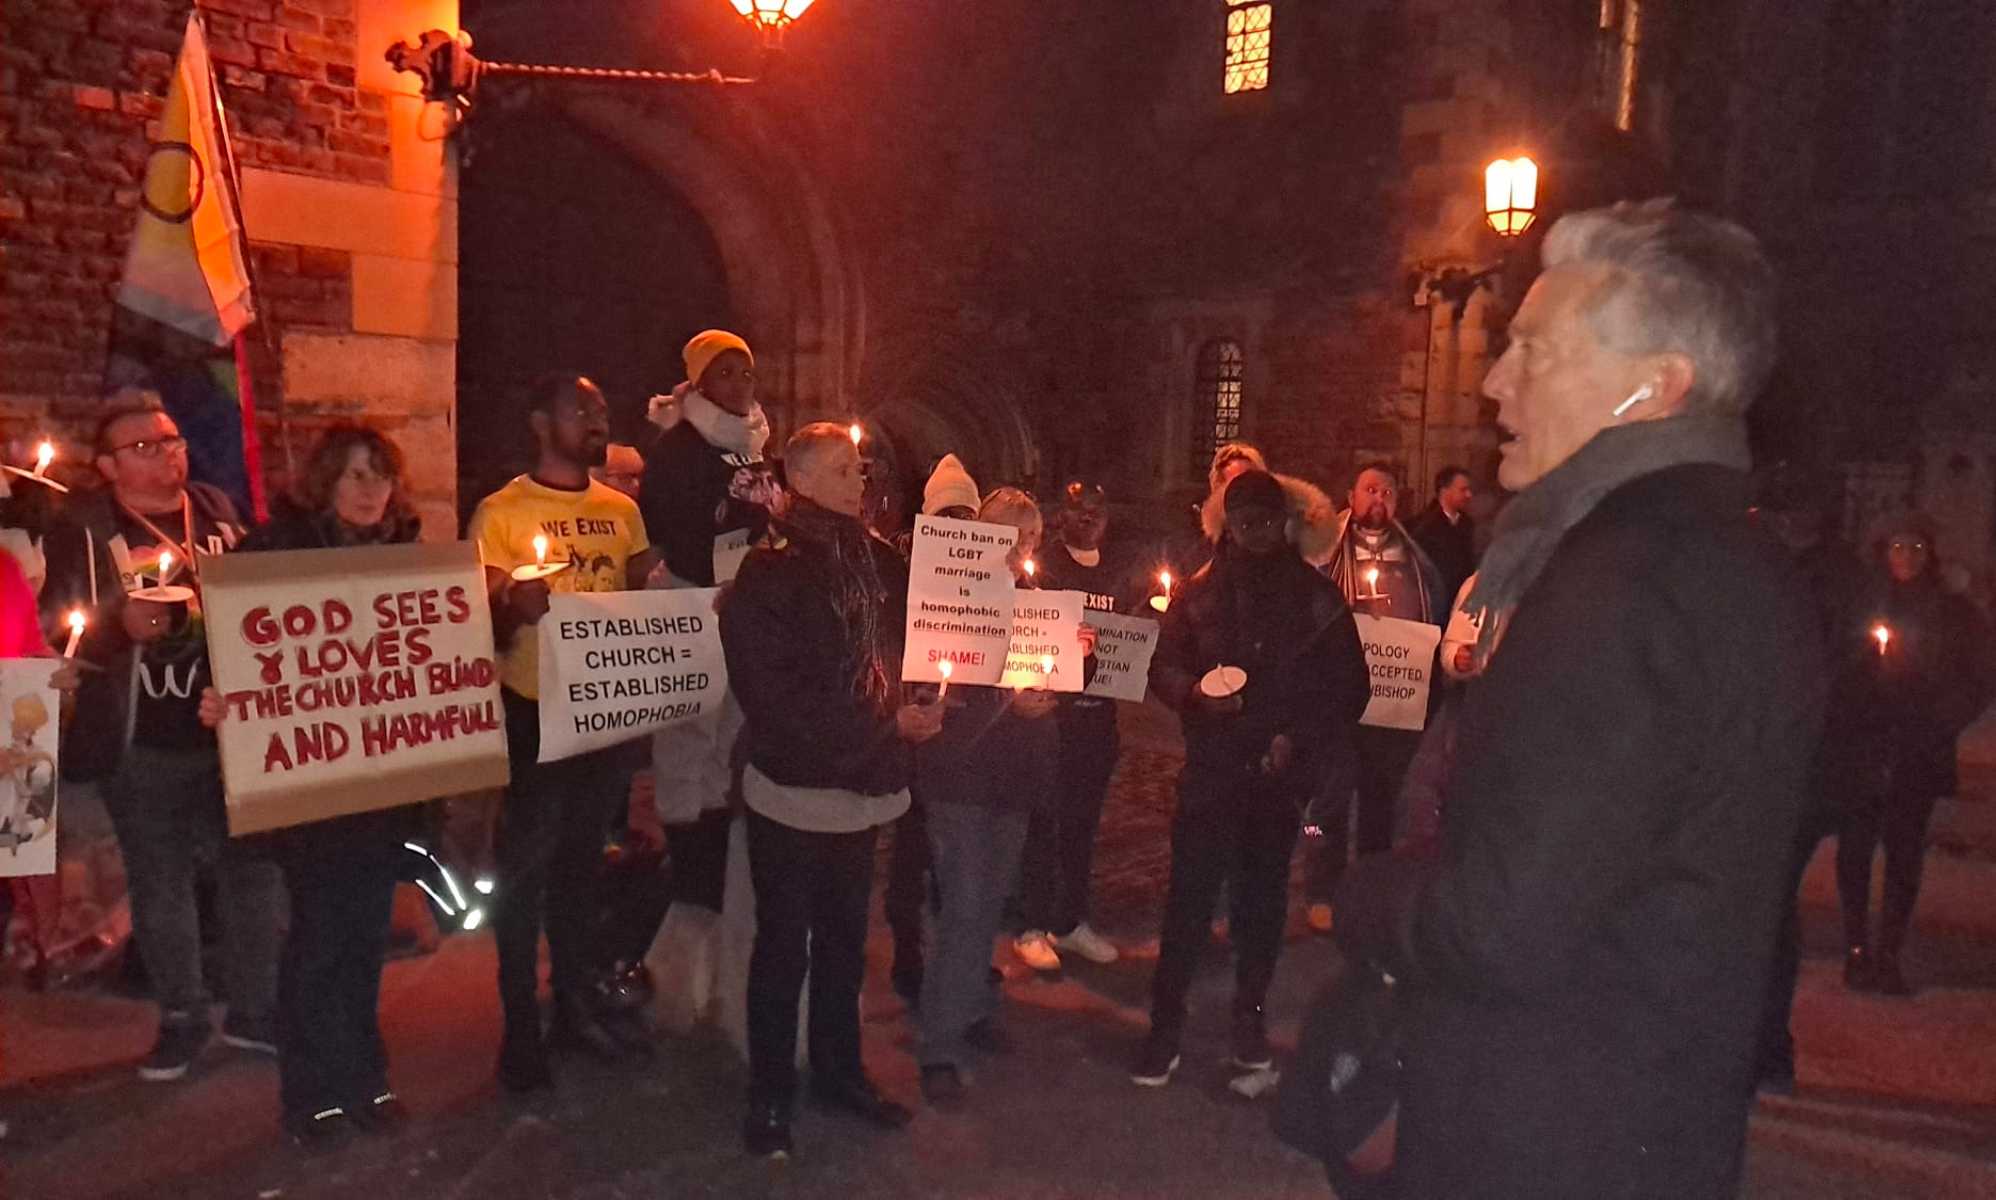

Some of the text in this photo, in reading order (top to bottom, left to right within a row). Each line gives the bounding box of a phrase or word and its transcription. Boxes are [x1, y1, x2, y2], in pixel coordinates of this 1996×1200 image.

[541, 518, 616, 537] WE EXIST
[921, 525, 1013, 546] Church ban on
[949, 548, 984, 561] LGBT
[935, 566, 991, 581] marriage
[242, 586, 470, 645] GOD SEES
[921, 601, 1001, 618] homophobic
[560, 616, 703, 640] ESTABLISHED
[913, 619, 1007, 637] discrimination
[1012, 625, 1039, 637] RCH
[296, 627, 433, 678] LOVES
[585, 645, 691, 669] CHURCH =
[928, 650, 985, 666] SHAME!
[225, 685, 293, 721] THE
[296, 666, 416, 711] CHURCH
[568, 673, 709, 702] ESTABLISHED
[1370, 684, 1415, 699] BISHOP
[574, 702, 701, 733] HOMOPHOBIA
[264, 721, 349, 773] AND
